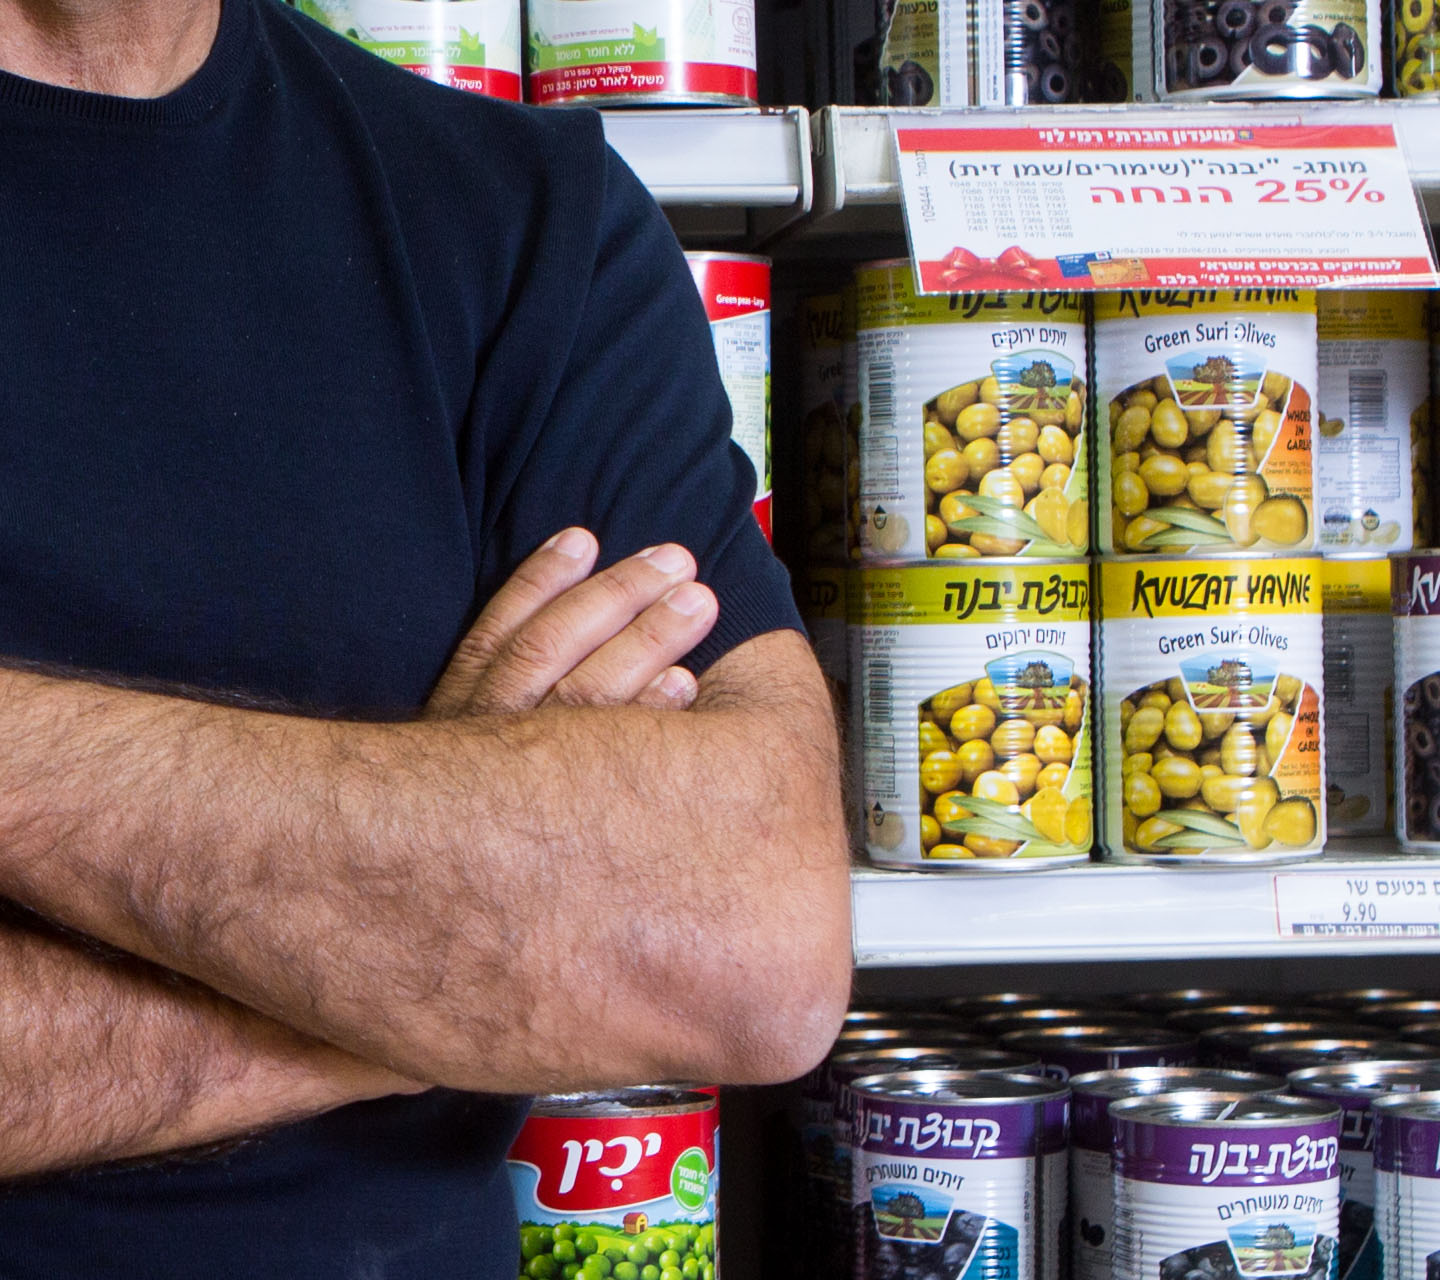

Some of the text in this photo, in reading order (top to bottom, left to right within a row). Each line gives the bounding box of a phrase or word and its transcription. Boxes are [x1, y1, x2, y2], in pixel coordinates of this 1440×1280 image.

[1039, 128, 1235, 144] מועדון חברתי רמי לוי
[1293, 158, 1368, 177] מותג-
[1090, 178, 1385, 205] 25% הנחה
[1132, 570, 1310, 619] KVUZAT YAVNE
[1159, 625, 1289, 655] Green Suri Olives
